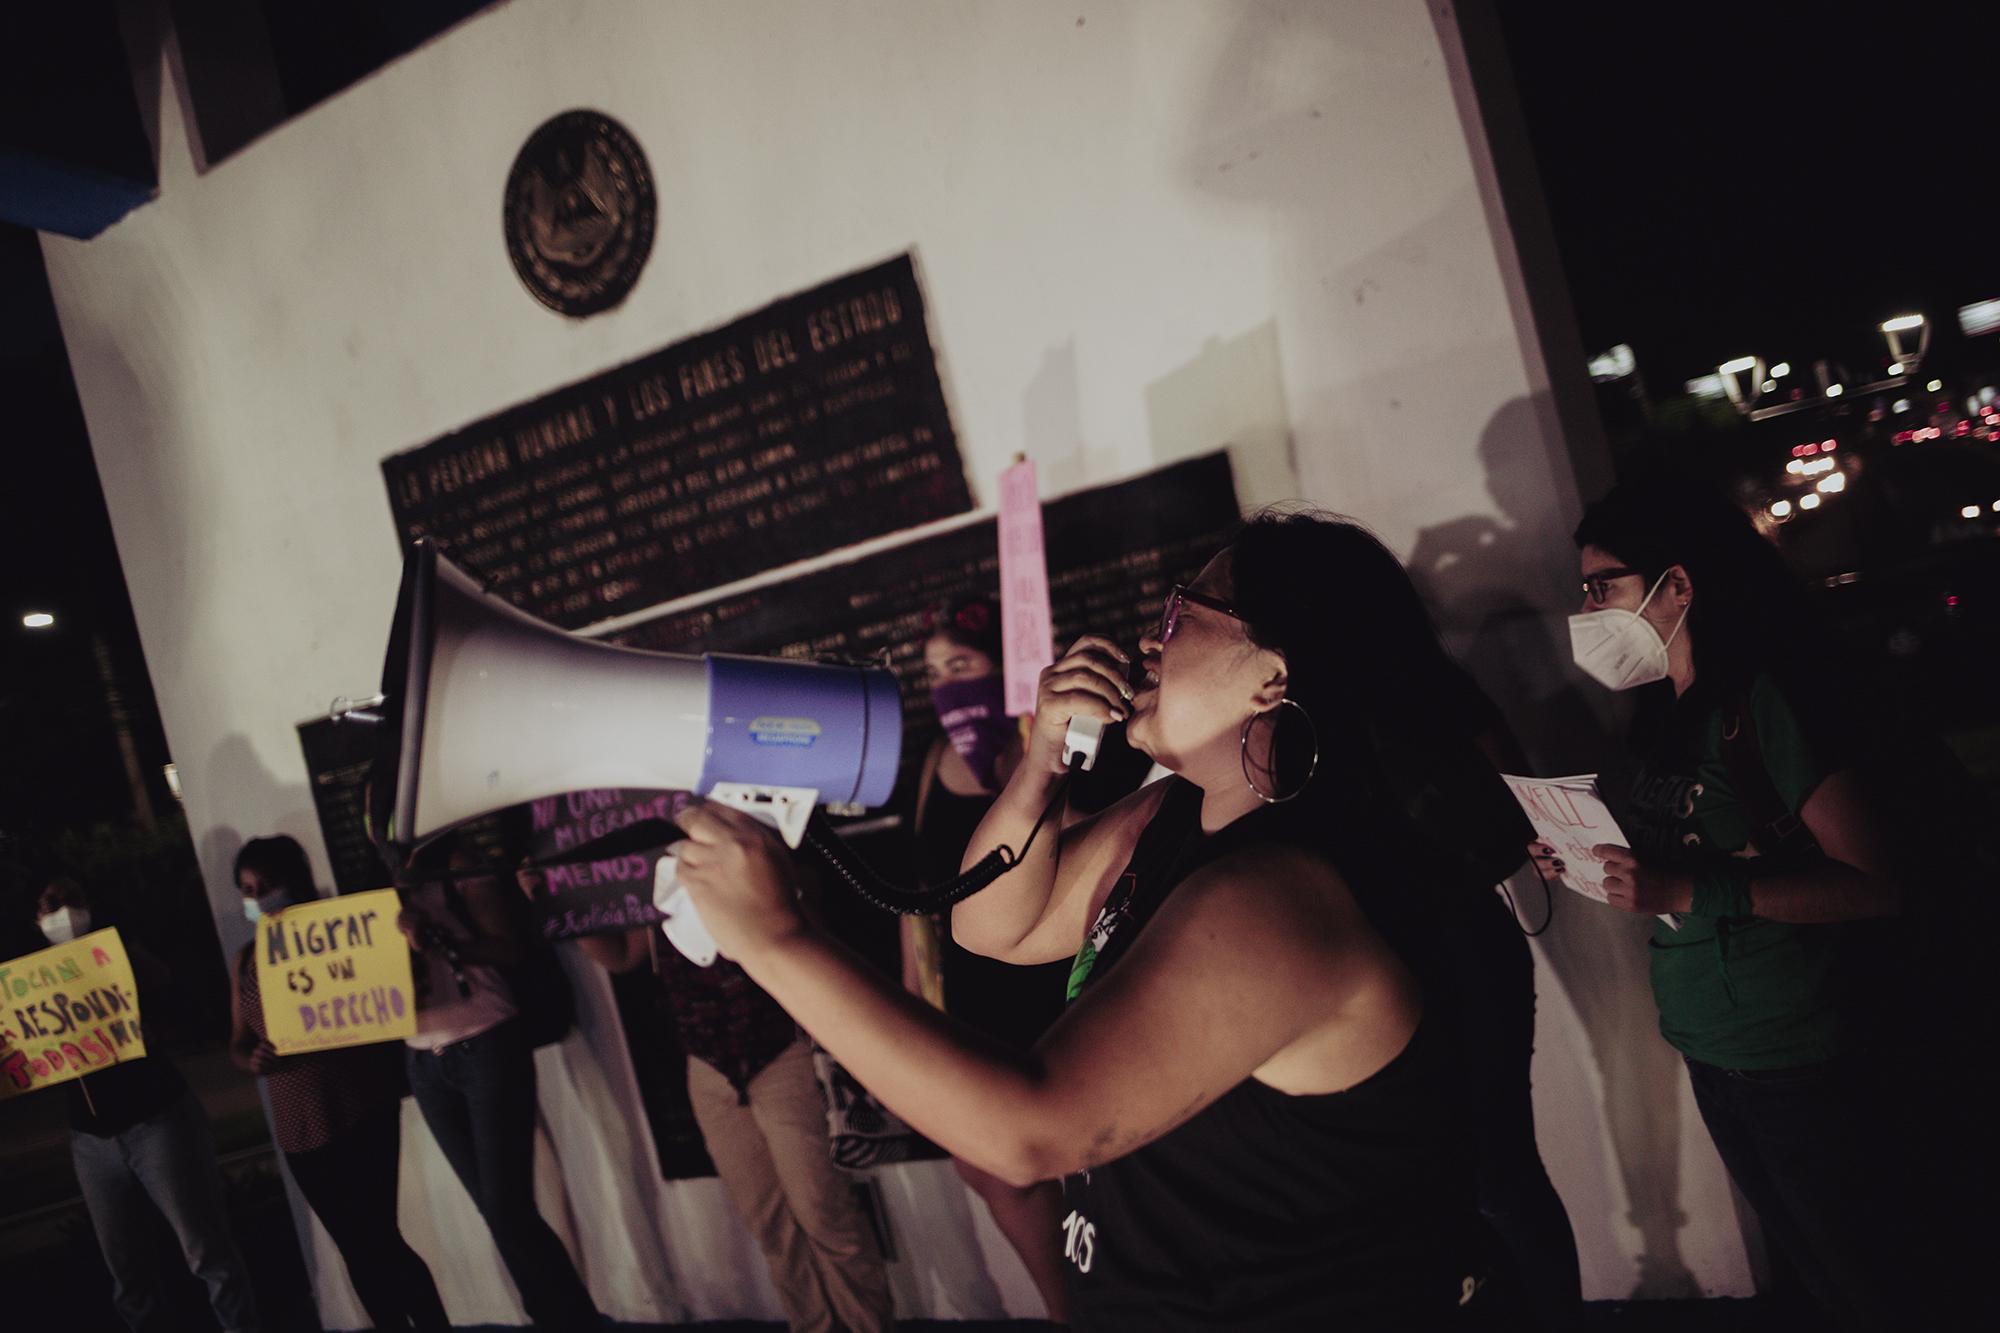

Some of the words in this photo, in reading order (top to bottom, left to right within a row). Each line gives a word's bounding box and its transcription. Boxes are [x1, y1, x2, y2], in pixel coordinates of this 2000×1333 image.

[429, 437, 508, 494] PERSONA
[515, 404, 596, 462] HUMANA
[628, 371, 671, 421] LOS
[678, 345, 746, 400] FINES
[752, 329, 797, 374] DEL
[807, 286, 902, 351] ESTADO
[545, 854, 648, 895] MENOS
[92, 947, 111, 967] A
[288, 966, 314, 994] ES
[327, 957, 355, 980] UN
[300, 986, 405, 1032] DERECHO
